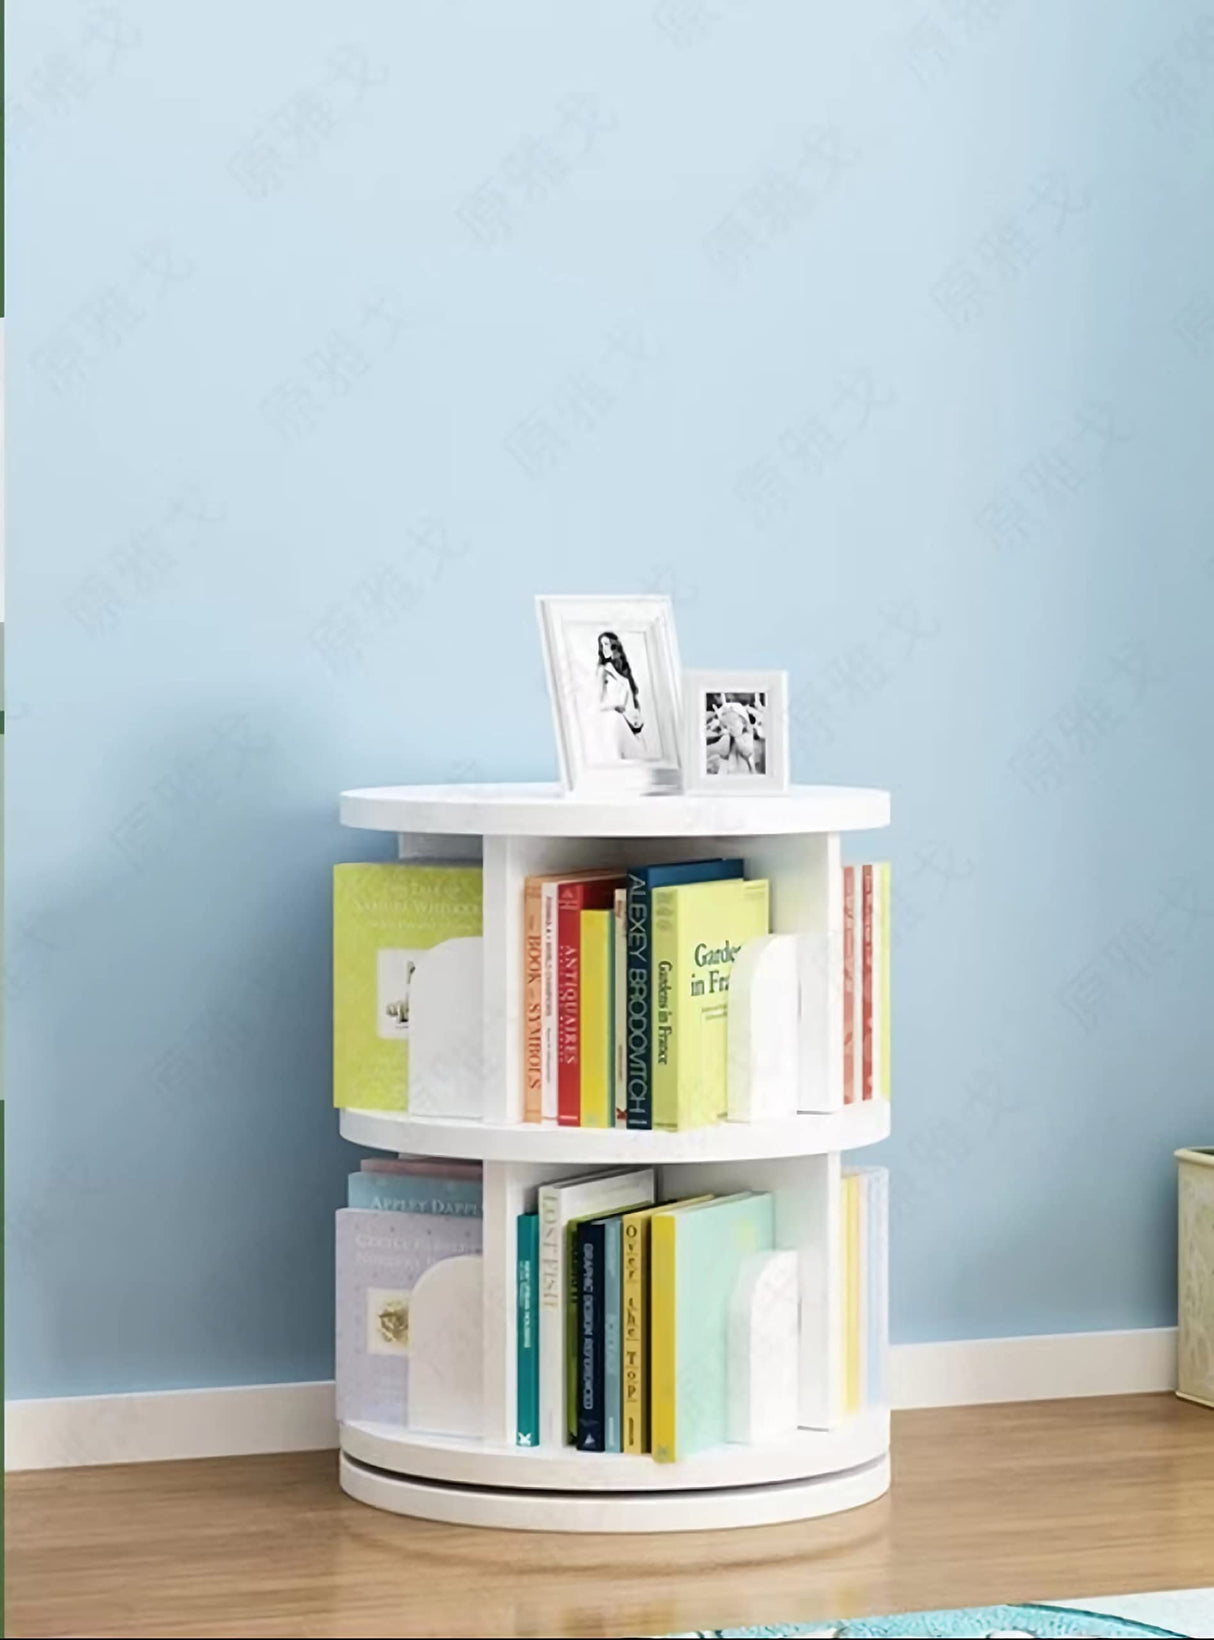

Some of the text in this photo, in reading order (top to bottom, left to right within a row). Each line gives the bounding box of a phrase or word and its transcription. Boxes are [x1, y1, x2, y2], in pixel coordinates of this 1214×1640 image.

[527, 935, 542, 985] BOOK
[628, 874, 648, 963] ALEXEY
[694, 939, 742, 968] Garde
[562, 944, 579, 1065] ANTIQUAIRES
[657, 960, 673, 1065] Gardens in France
[690, 973, 706, 997] in
[527, 1002, 542, 1090] SYMBOLS
[628, 967, 648, 1113] BRODOVITCH
[371, 1195, 429, 1214] APPLEY
